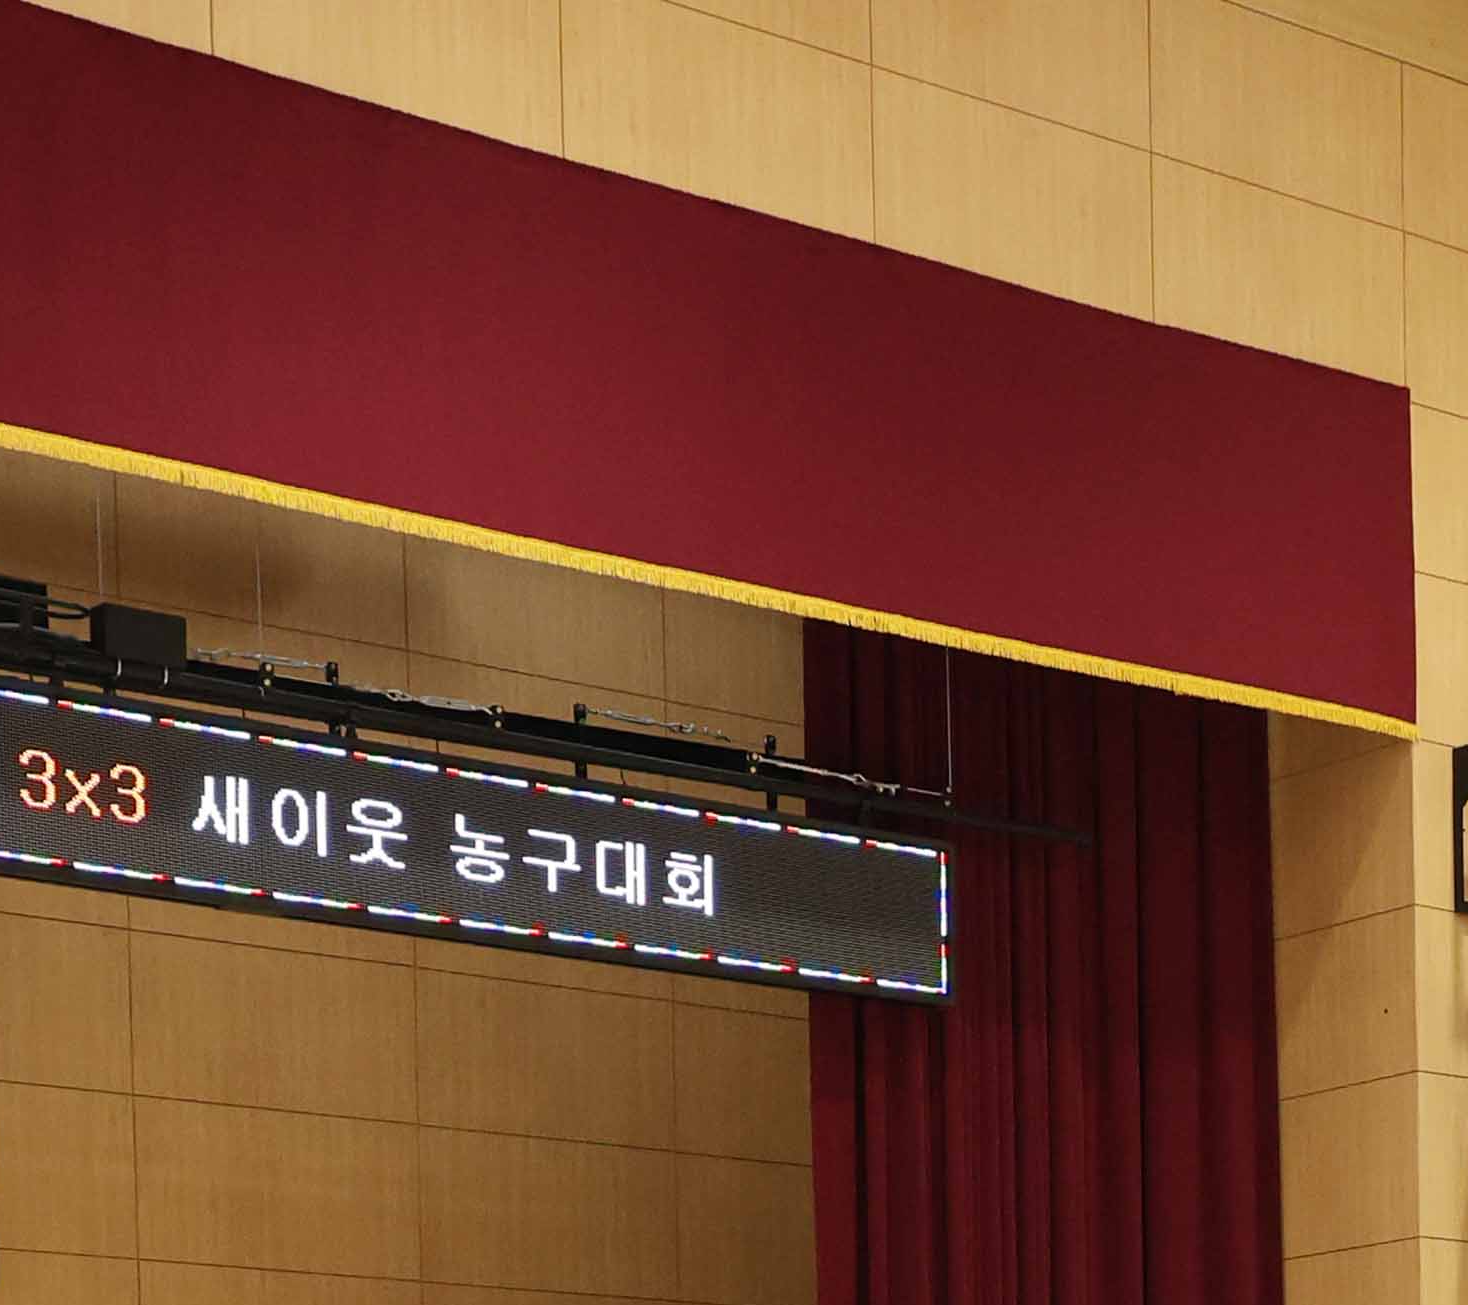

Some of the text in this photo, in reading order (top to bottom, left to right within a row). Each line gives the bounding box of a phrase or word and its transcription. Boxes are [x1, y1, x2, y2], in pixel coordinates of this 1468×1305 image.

[16, 748, 150, 825] 3x3
[191, 772, 409, 874] 새이웃
[447, 812, 718, 919] 농구대회
